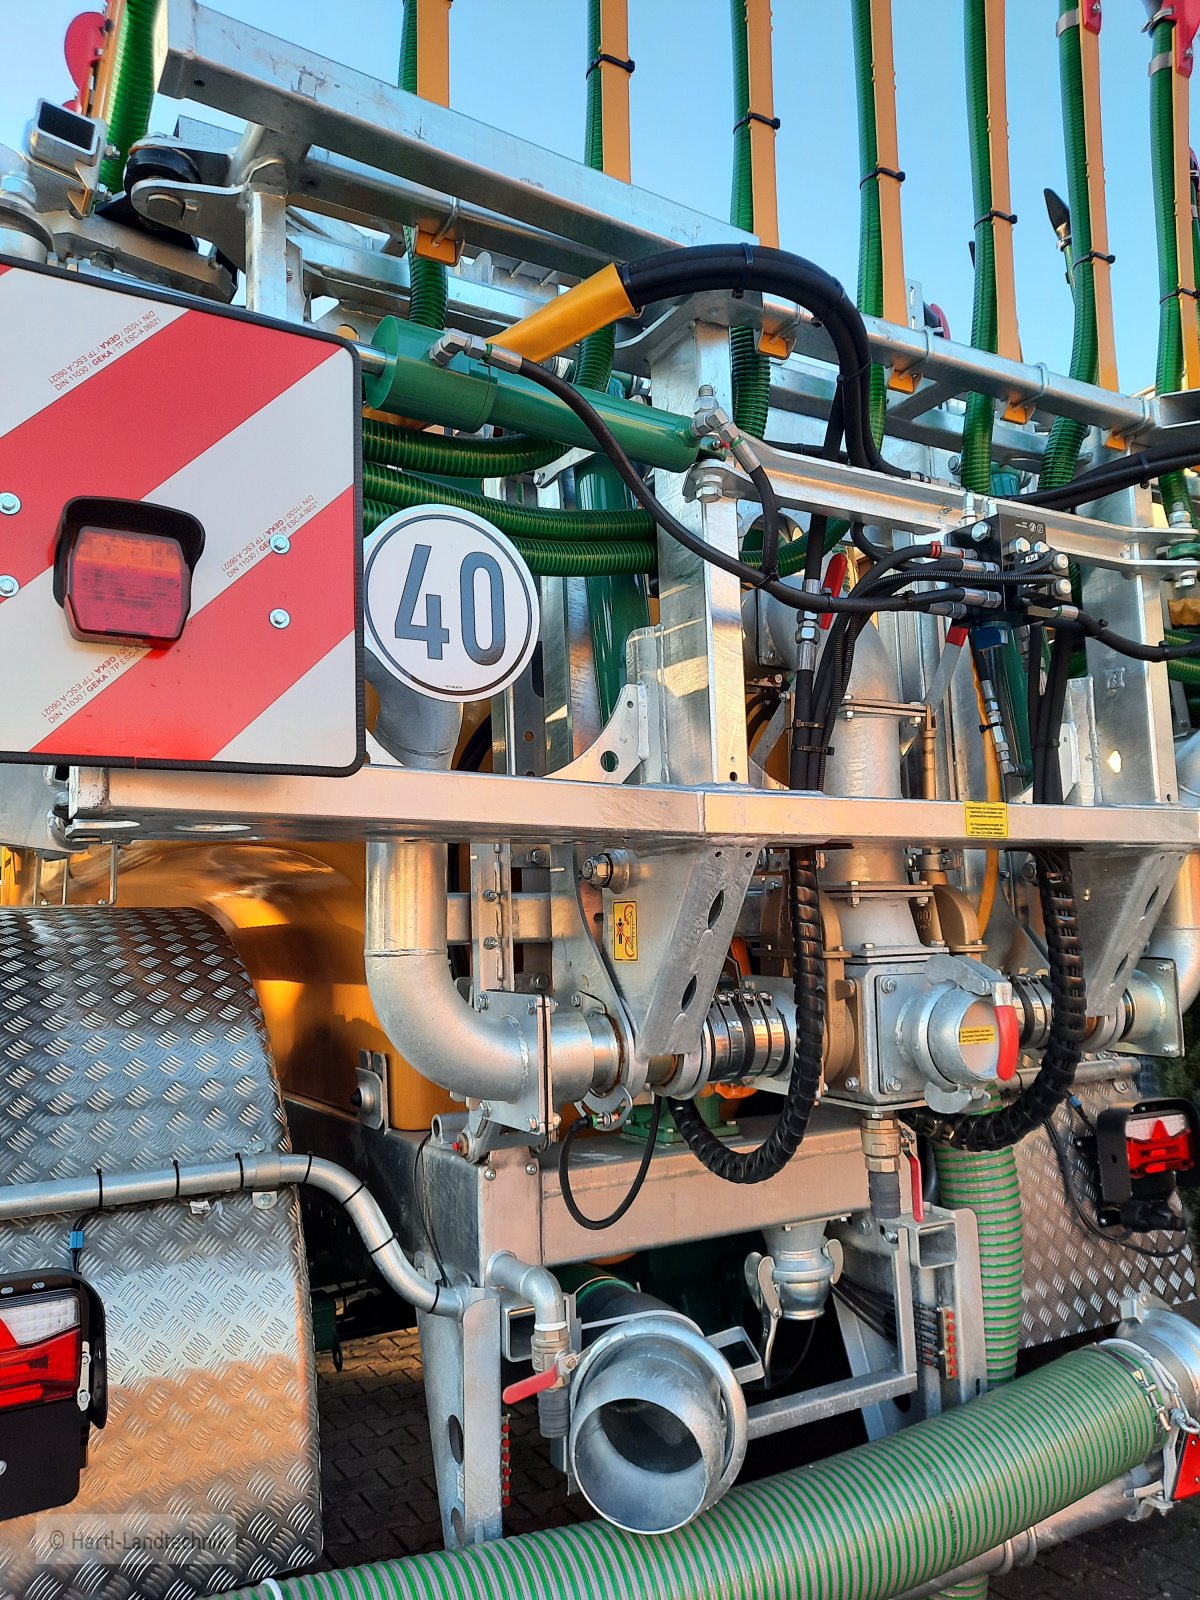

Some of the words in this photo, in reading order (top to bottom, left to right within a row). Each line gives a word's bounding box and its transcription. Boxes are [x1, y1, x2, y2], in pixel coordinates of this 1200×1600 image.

[54, 379, 70, 391] DIN
[69, 366, 89, 381] 11030
[92, 350, 113, 366] GEKA
[114, 341, 125, 350] TP
[124, 328, 146, 344] ESC-A
[143, 317, 161, 331] 06021
[99, 333, 121, 349] GEKA
[226, 566, 240, 578] DIN
[239, 552, 257, 568] 11030
[286, 513, 305, 528] ESC-A
[303, 501, 320, 515] 06021
[265, 519, 284, 536] GEKA
[395, 543, 506, 667] 40
[48, 710, 63, 724] DIN
[62, 694, 84, 711] 11030
[86, 674, 109, 692] GEKA
[111, 662, 120, 672] TP
[94, 656, 116, 674] GEKA
